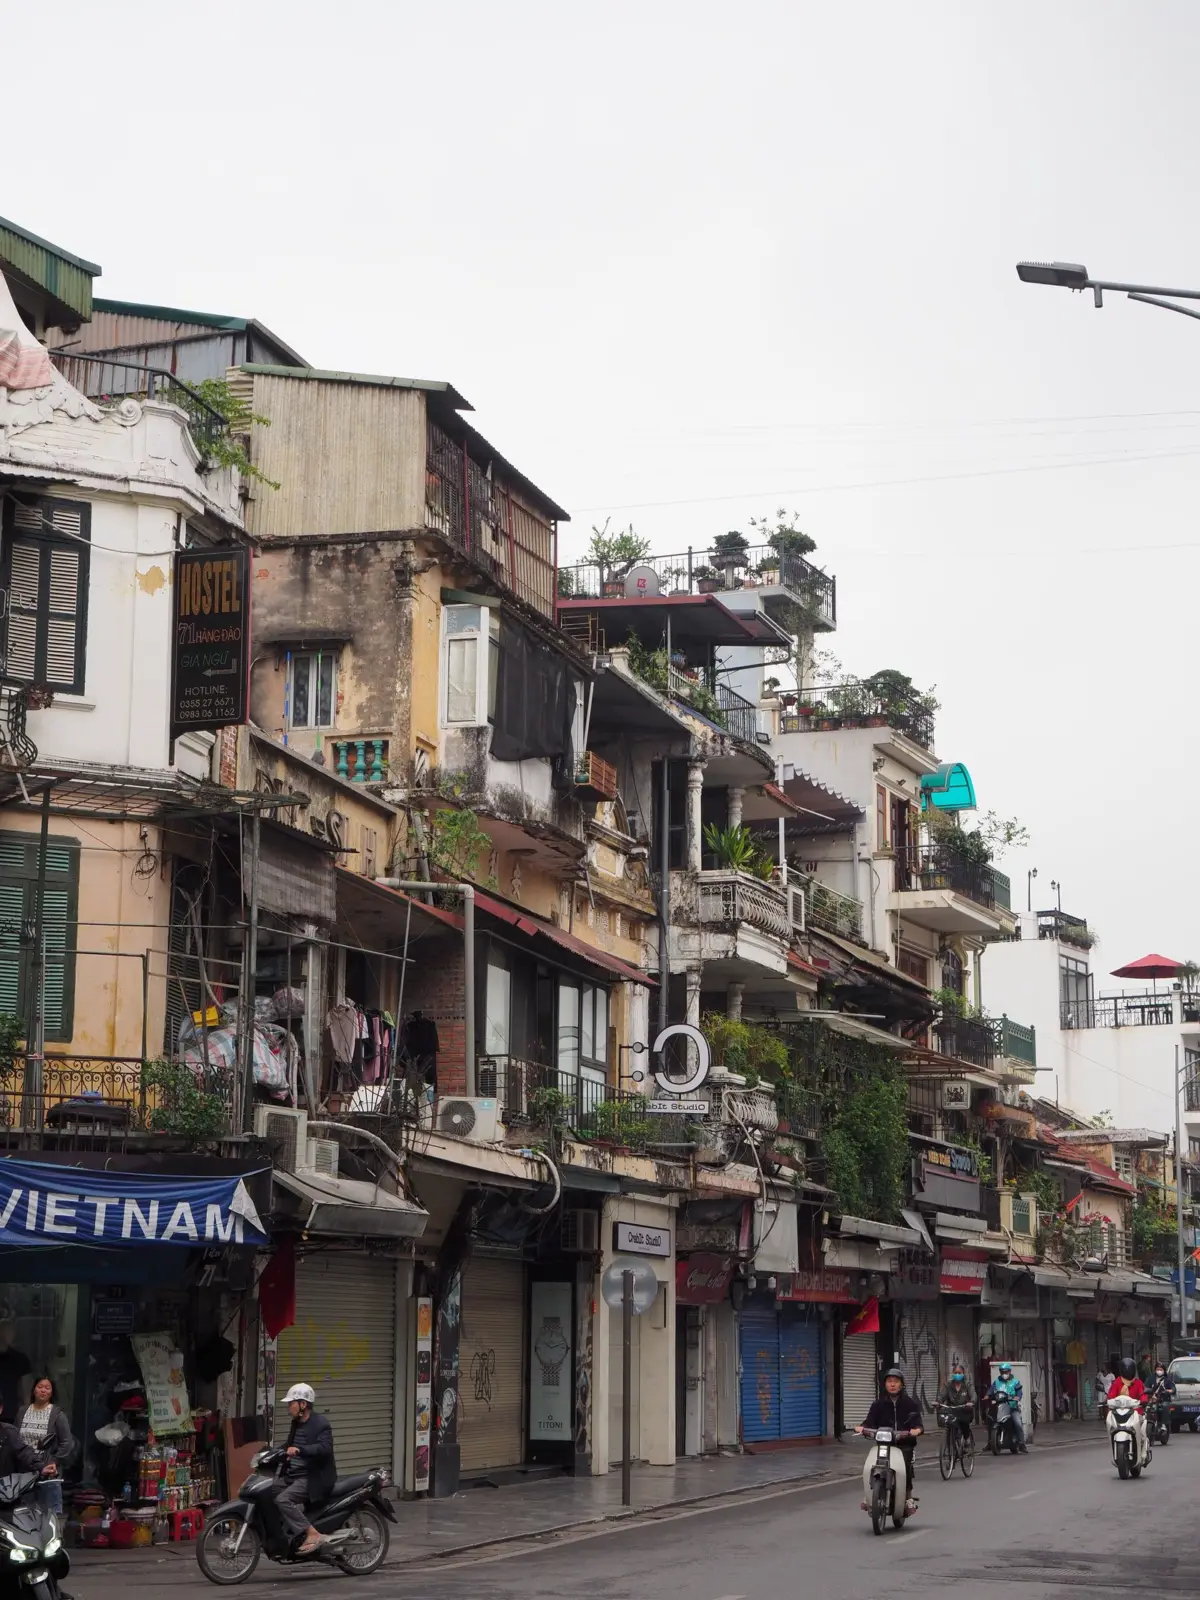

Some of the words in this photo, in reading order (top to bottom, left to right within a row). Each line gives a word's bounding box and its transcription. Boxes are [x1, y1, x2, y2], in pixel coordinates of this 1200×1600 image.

[180, 559, 240, 616] HOSTEL
[178, 623, 196, 644] 71
[184, 684, 228, 696] HOTLINE:
[179, 699, 202, 709] 0355
[202, 698, 212, 708] 27
[213, 696, 235, 706] 6671
[179, 709, 200, 719] 0983
[201, 708, 213, 718] 06
[214, 707, 236, 718] 1162
